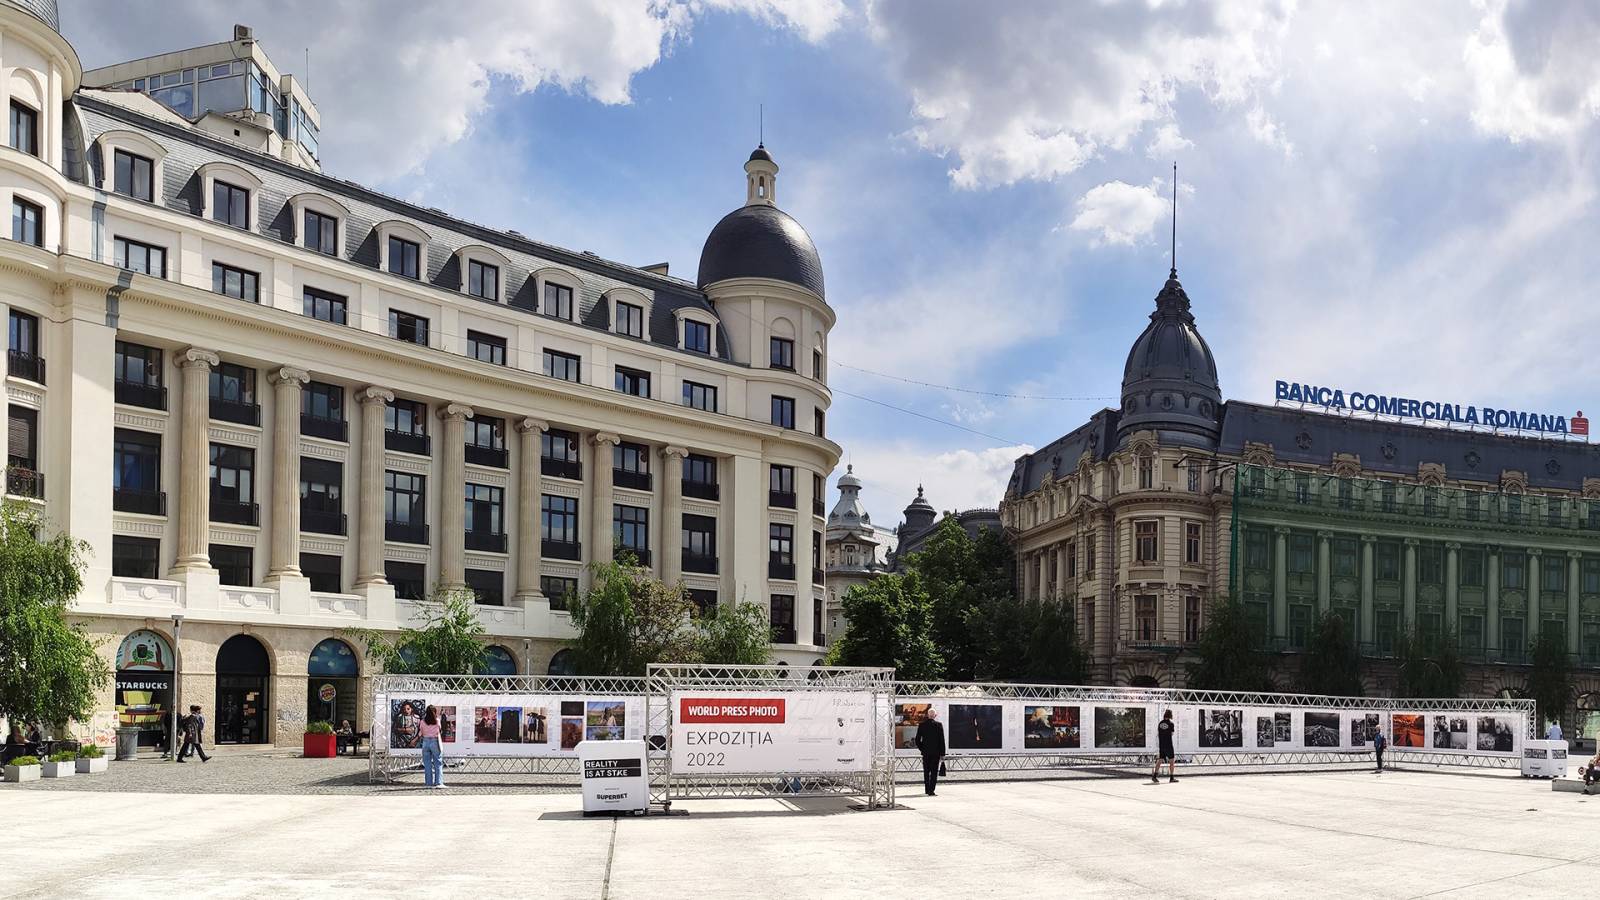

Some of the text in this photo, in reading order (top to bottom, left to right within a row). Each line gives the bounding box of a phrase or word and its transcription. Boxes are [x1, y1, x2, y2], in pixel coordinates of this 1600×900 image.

[1275, 380, 1568, 433] BANCA COMERCIALA ROMANA
[116, 681, 168, 690] STARBUCKS
[688, 706, 778, 716] WORLD PRESS PHOTO
[687, 731, 773, 748] EXPOZIȚIA
[585, 760, 618, 768] REALITY
[687, 752, 725, 766] 2022
[586, 770, 594, 778] IS
